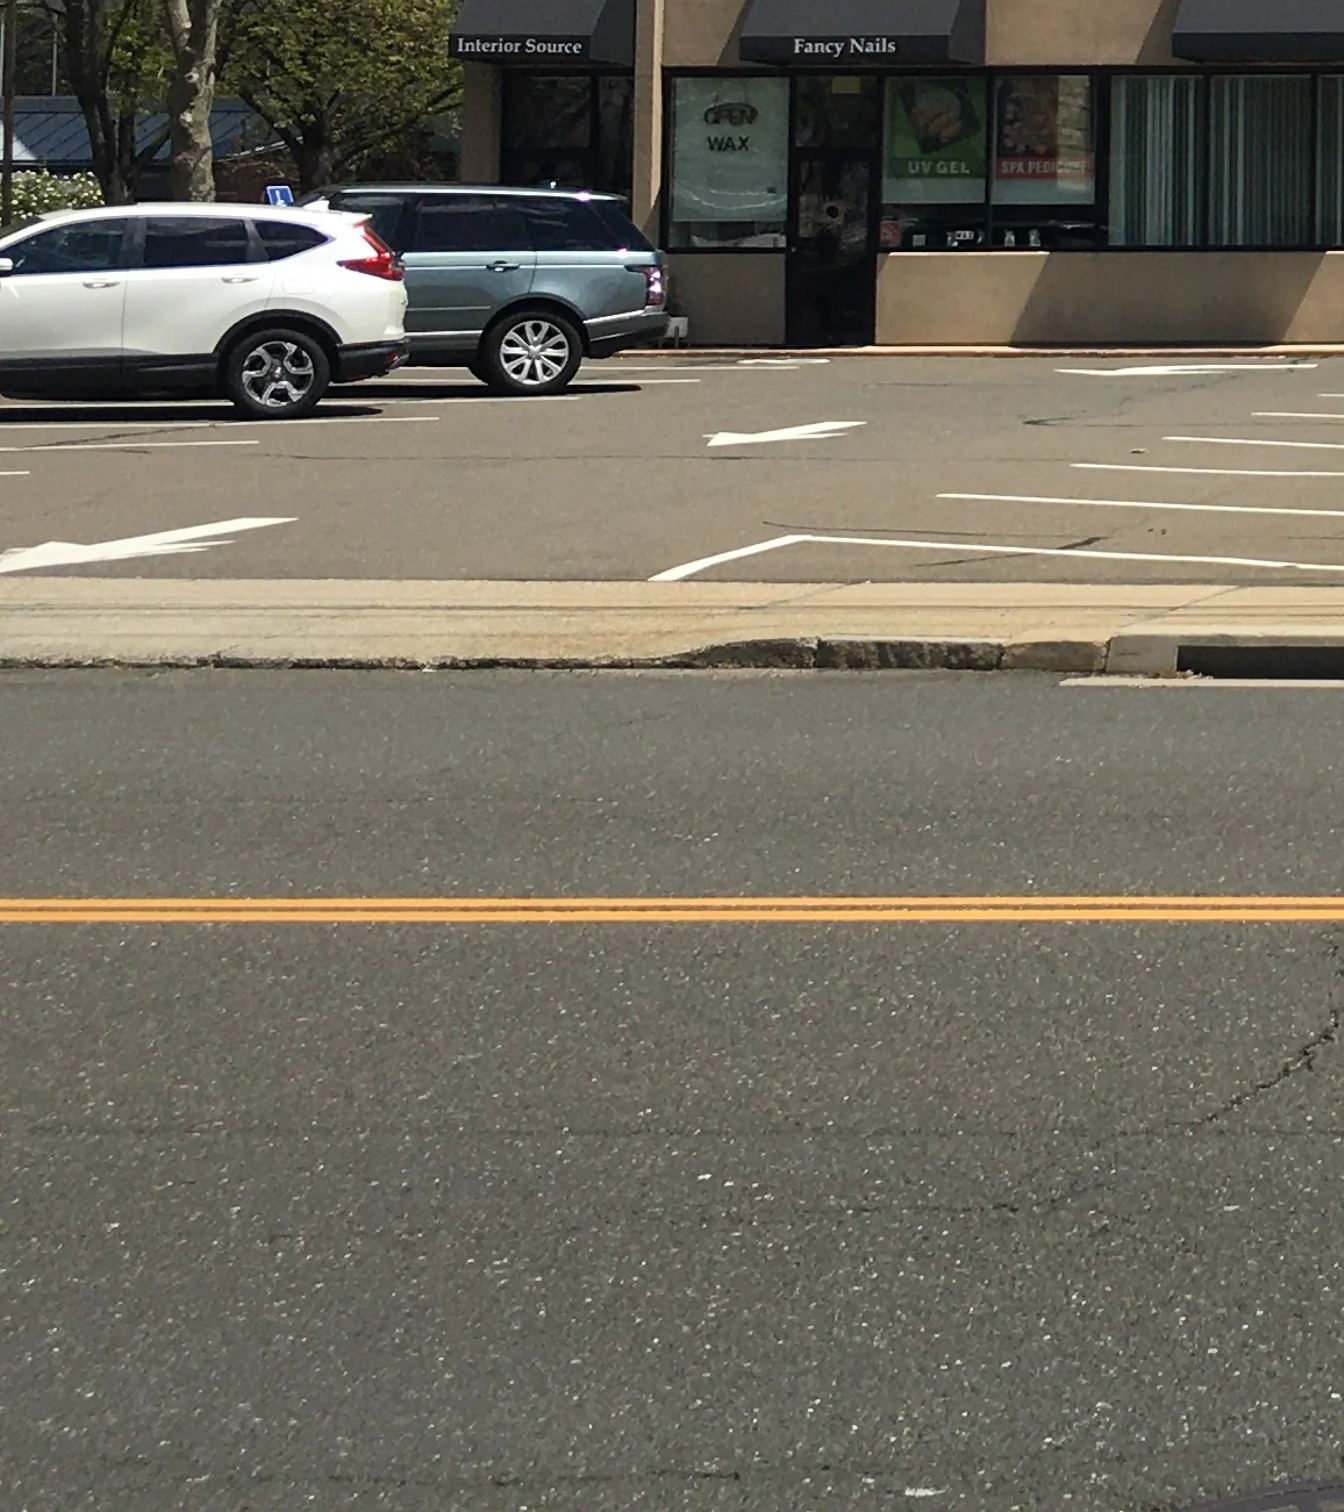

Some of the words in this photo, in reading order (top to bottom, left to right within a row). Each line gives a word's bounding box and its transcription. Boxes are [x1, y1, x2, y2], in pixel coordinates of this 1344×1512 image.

[457, 37, 521, 53] Interior
[525, 38, 582, 54] Source
[794, 38, 845, 58] Fancy
[849, 37, 896, 53] Nails
[707, 136, 750, 152] WAX
[908, 160, 933, 174] UV
[936, 160, 971, 174] GEL
[1001, 160, 1025, 174] SPA
